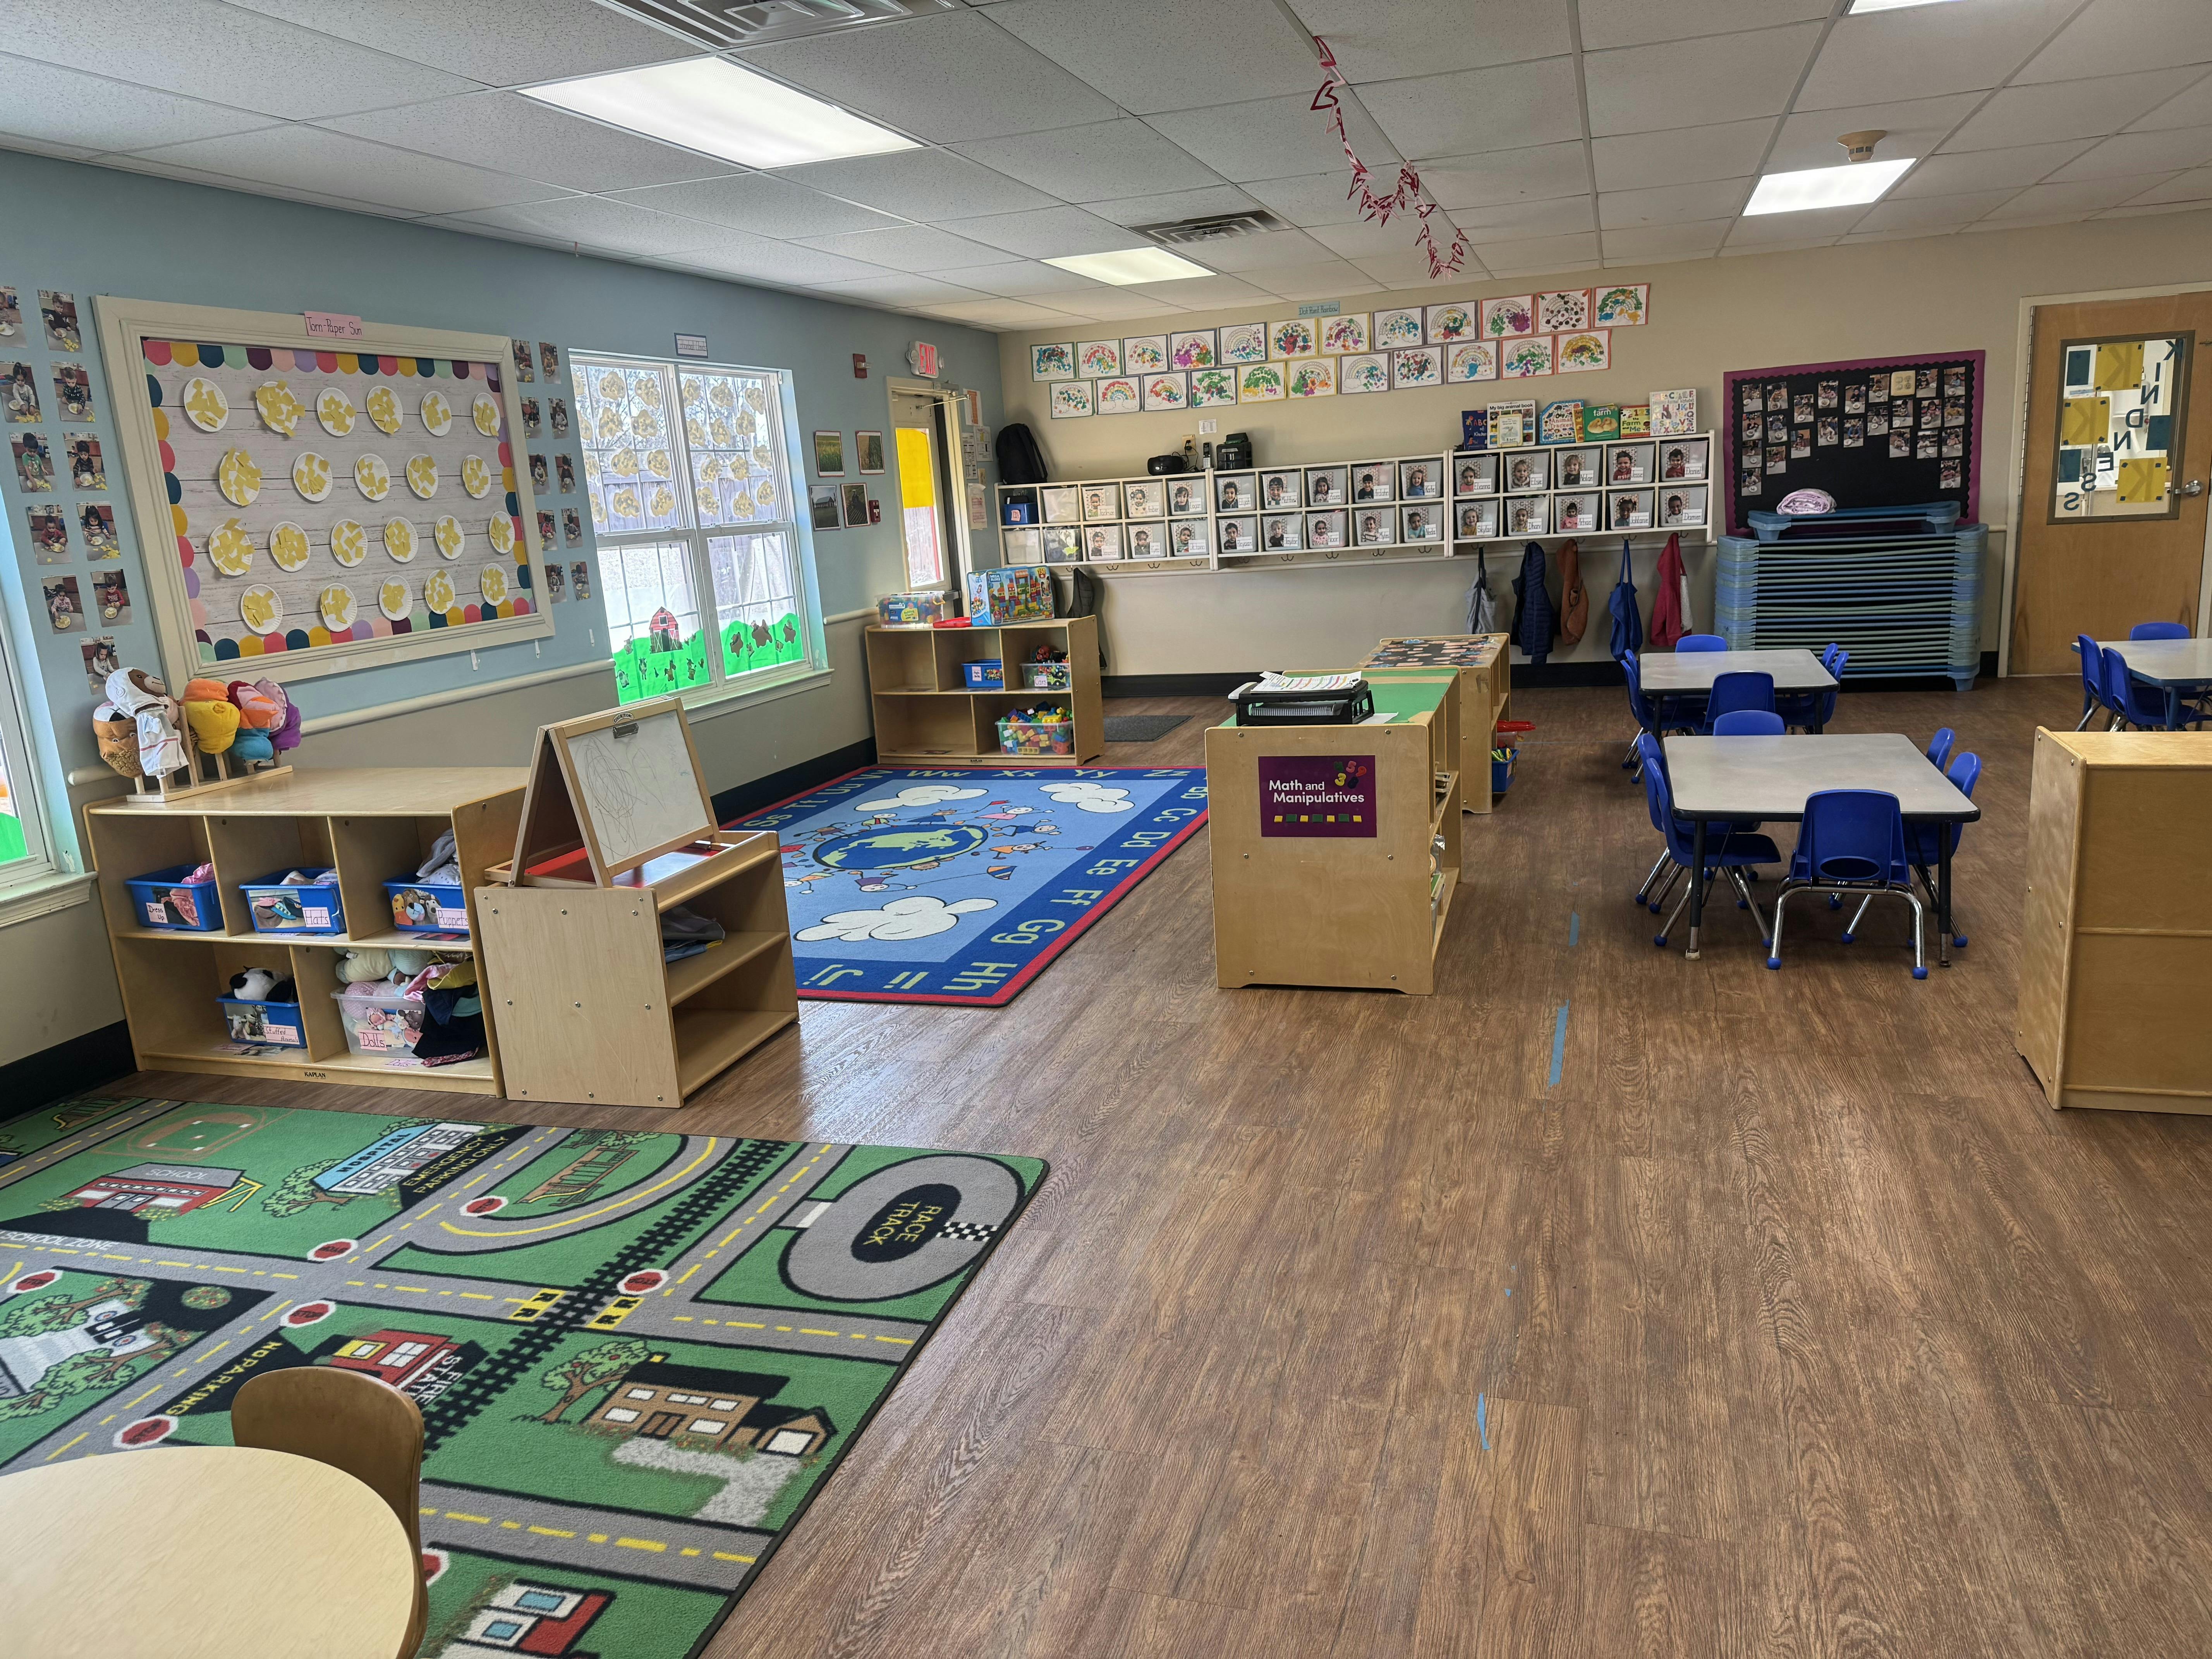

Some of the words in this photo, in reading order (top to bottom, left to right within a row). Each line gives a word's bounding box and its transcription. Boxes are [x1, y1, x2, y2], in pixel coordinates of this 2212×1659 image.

[1321, 305, 1338, 313] Rainbow
[306, 317, 345, 337] Torn-Paper
[349, 321, 362, 335] Sun
[919, 343, 936, 375] EXIT
[1631, 470, 1643, 478] Jesse
[1685, 466, 1701, 475] Daniel
[1531, 477, 1542, 485] Elsie
[1580, 474, 1593, 482] Nolan
[1683, 512, 1701, 520] Damien
[1379, 531, 1389, 540] Myles
[1477, 524, 1492, 534] Skylar
[1285, 537, 1297, 545] Taylor
[1034, 677, 1047, 685] Cars
[1074, 769, 1117, 778] Yy
[1346, 761, 1356, 773] 5
[1355, 766, 1367, 776] 9
[1269, 780, 1302, 790] Math
[1305, 781, 1324, 790] and
[1334, 773, 1346, 786] 3
[816, 783, 865, 795] Uu
[783, 799, 829, 809] Tt
[1274, 792, 1364, 805] Manipulatives
[743, 814, 793, 827] Ss
[1152, 808, 1197, 822] Cc
[1120, 831, 1171, 848] Dd
[1086, 859, 1139, 875] Ee
[1050, 889, 1104, 906] Ff
[148, 904, 163, 913] Dress
[306, 909, 329, 925] Hats
[438, 910, 469, 928] Puppets
[991, 919, 1065, 944] Gg
[941, 962, 1018, 991] Hh
[265, 1026, 286, 1035] Stuffed
[362, 1032, 385, 1048] Dolls
[337, 1132, 411, 1173] HOSPITAL
[402, 1136, 487, 1187] EMERGENCY
[413, 1157, 471, 1194] PARKING
[472, 1136, 509, 1158] ONLY
[146, 1168, 208, 1180] SCHOOL
[863, 1200, 922, 1245] TRACK
[895, 1205, 944, 1242] RACE
[0, 1231, 65, 1245] SCHOOL
[65, 1239, 118, 1251] ZONE
[252, 1341, 283, 1358] NO
[166, 1357, 259, 1415] PARKING
[413, 1371, 463, 1405] FIRE
